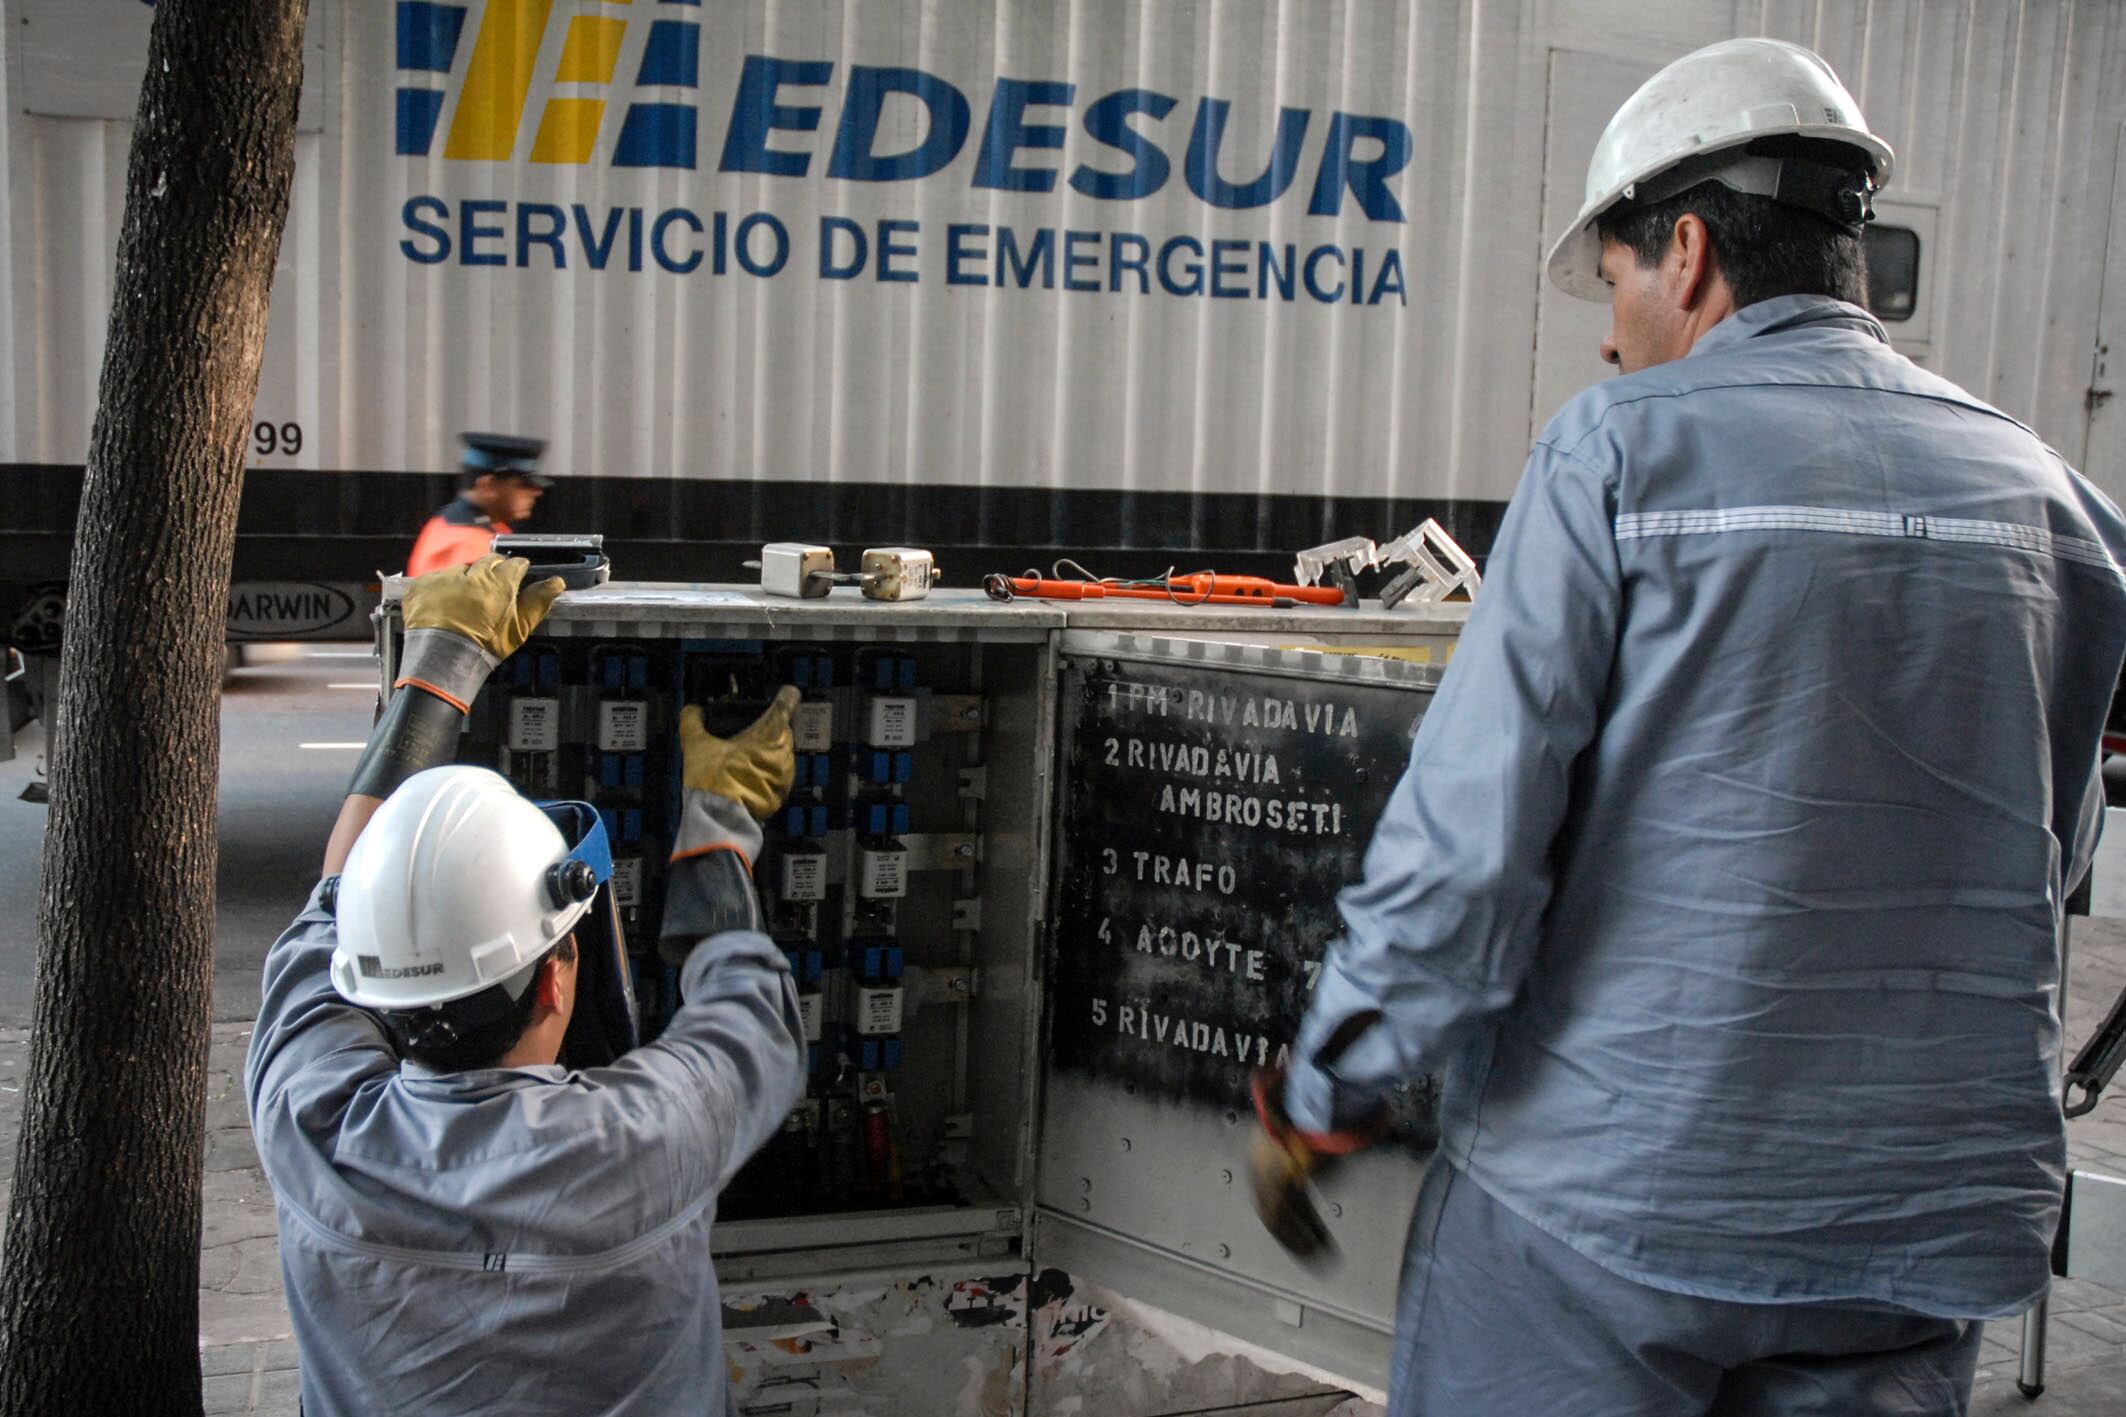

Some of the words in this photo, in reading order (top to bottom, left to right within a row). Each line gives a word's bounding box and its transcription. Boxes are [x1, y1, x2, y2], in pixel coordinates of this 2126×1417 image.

[718, 54, 1414, 223] EDESUR
[399, 195, 791, 278] SERVICIO
[820, 216, 919, 283] DE
[946, 223, 1406, 306] EMERGENCIA
[226, 592, 330, 621] ARWIN
[1187, 689, 1358, 738] RIVADAVIA
[1104, 738, 1119, 767] 2
[1128, 739, 1280, 784] RIVADAVIA
[1160, 785, 1341, 835] AMBROSETI
[1102, 848, 1118, 876] 3
[1134, 851, 1236, 895] TRAFO
[1091, 997, 1108, 1027] 5
[1118, 1005, 1291, 1071] RIVADAVIA
